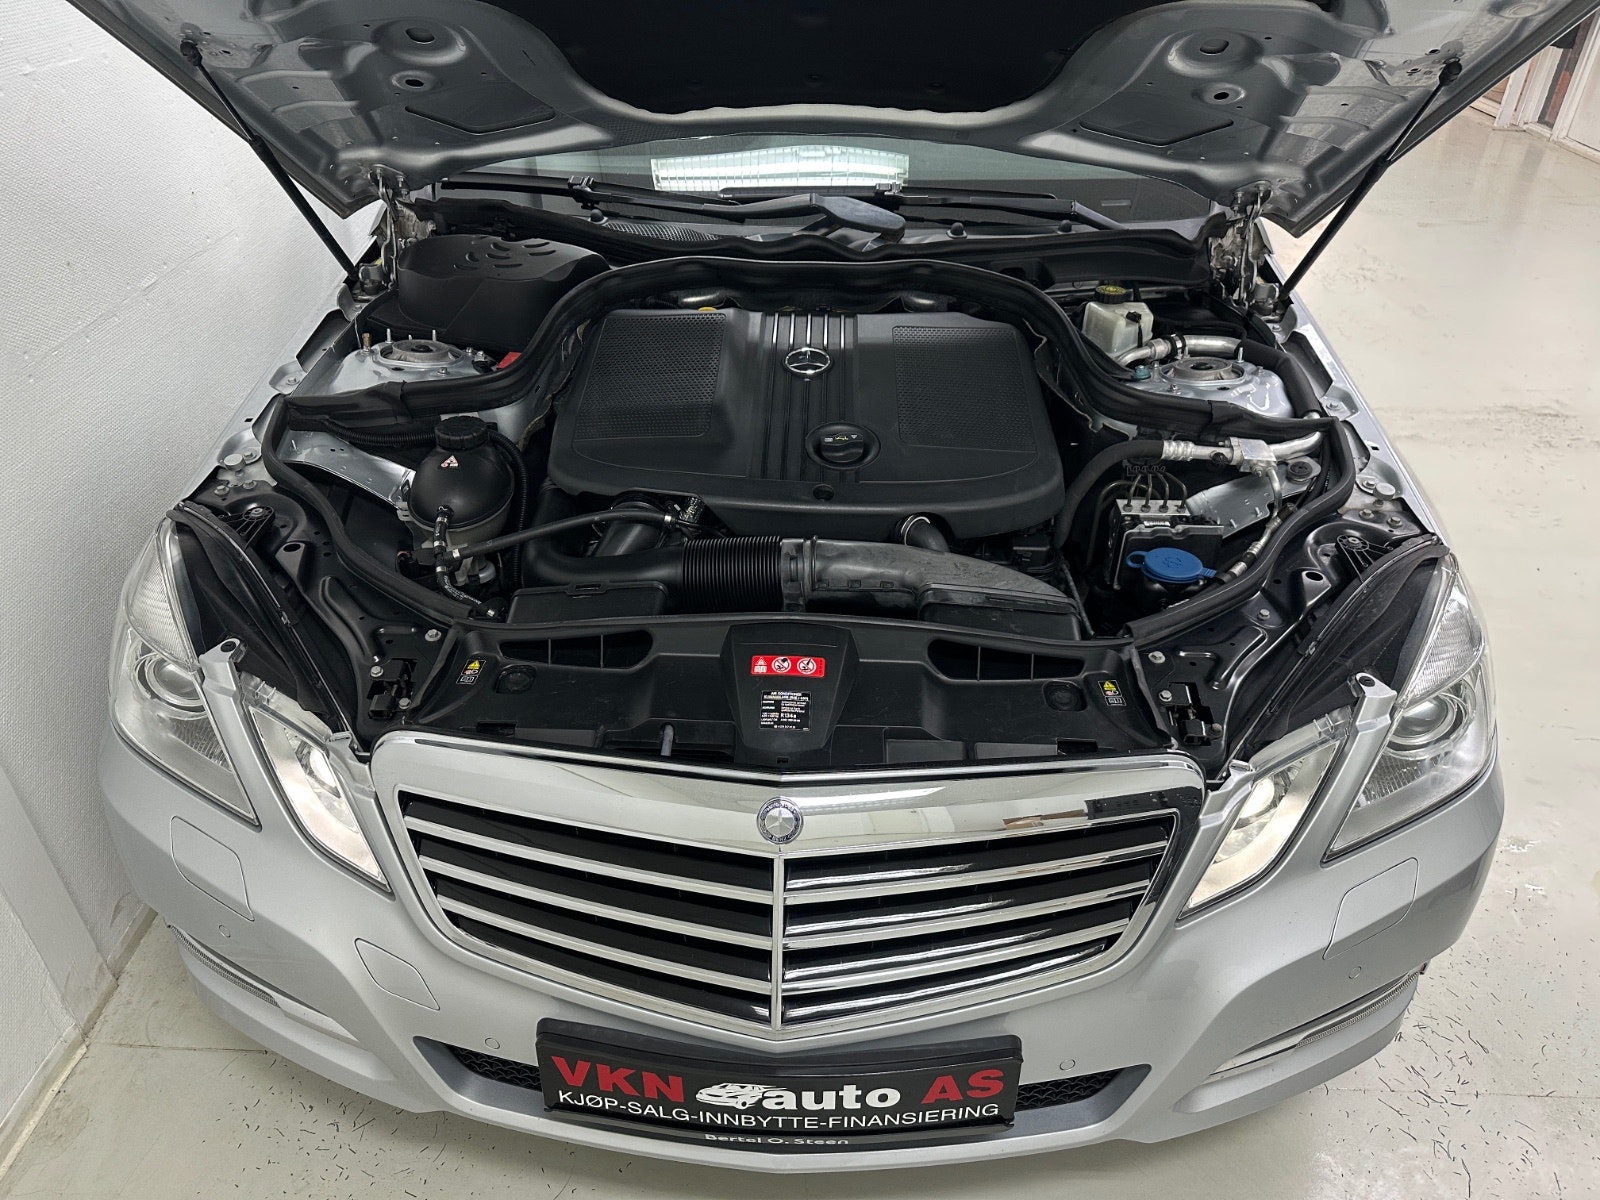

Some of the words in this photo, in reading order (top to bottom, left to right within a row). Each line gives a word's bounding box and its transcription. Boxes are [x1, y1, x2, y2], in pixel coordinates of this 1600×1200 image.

[551, 1056, 684, 1102] VKN
[762, 1084, 900, 1110] auto
[921, 1069, 1004, 1104] AS
[558, 1090, 999, 1129] KJØP-SALG-INNBYTTE-FINANSIERING
[794, 1137, 849, 1145] Steen
